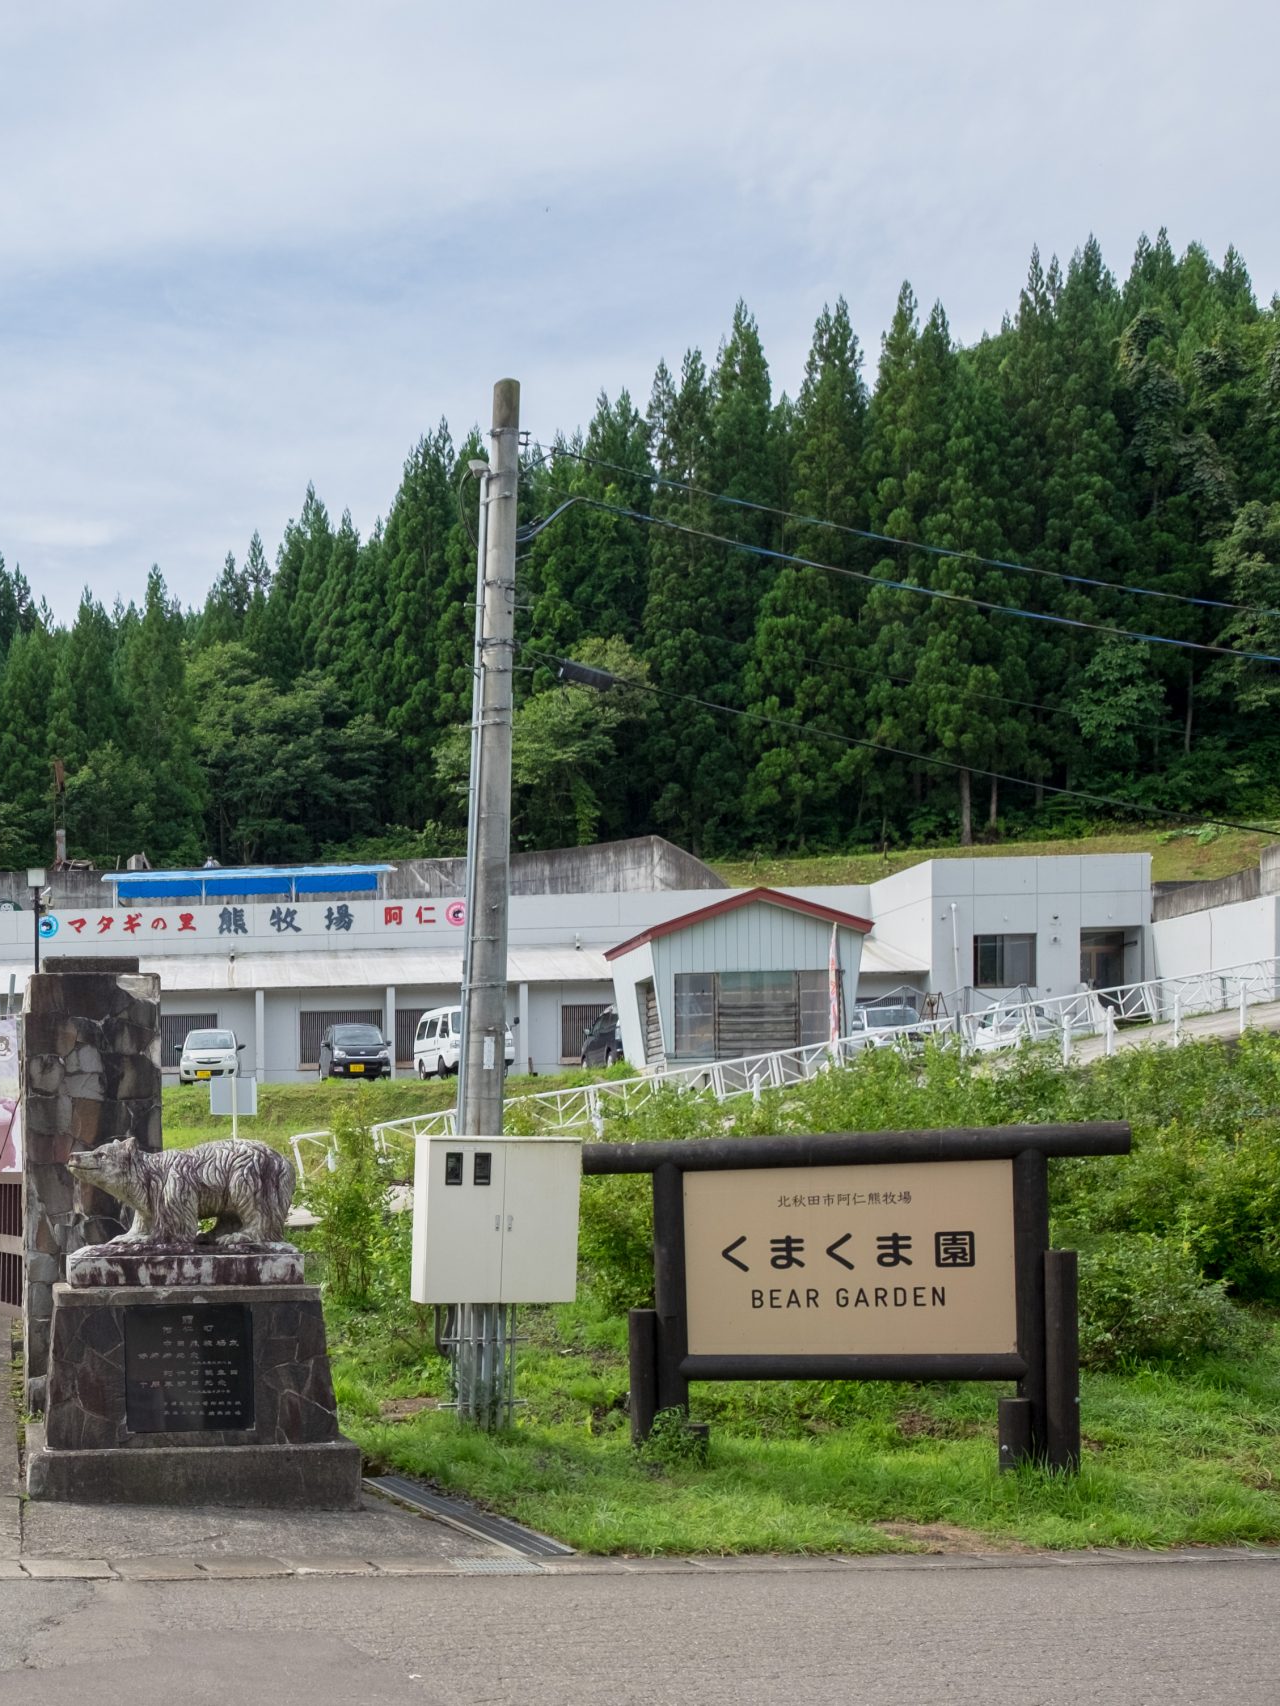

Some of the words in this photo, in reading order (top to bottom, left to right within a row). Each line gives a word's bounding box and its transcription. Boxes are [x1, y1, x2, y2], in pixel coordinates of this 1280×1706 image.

[67, 913, 197, 934] マタギの里
[218, 904, 354, 934] 熊牧場
[384, 906, 436, 926] 阿仁
[777, 1190, 912, 1208] 北秋田市阿仁熊牧場
[721, 1231, 975, 1272] くまくま園
[751, 1288, 820, 1309] BEAR
[835, 1286, 946, 1308] GARDEN
